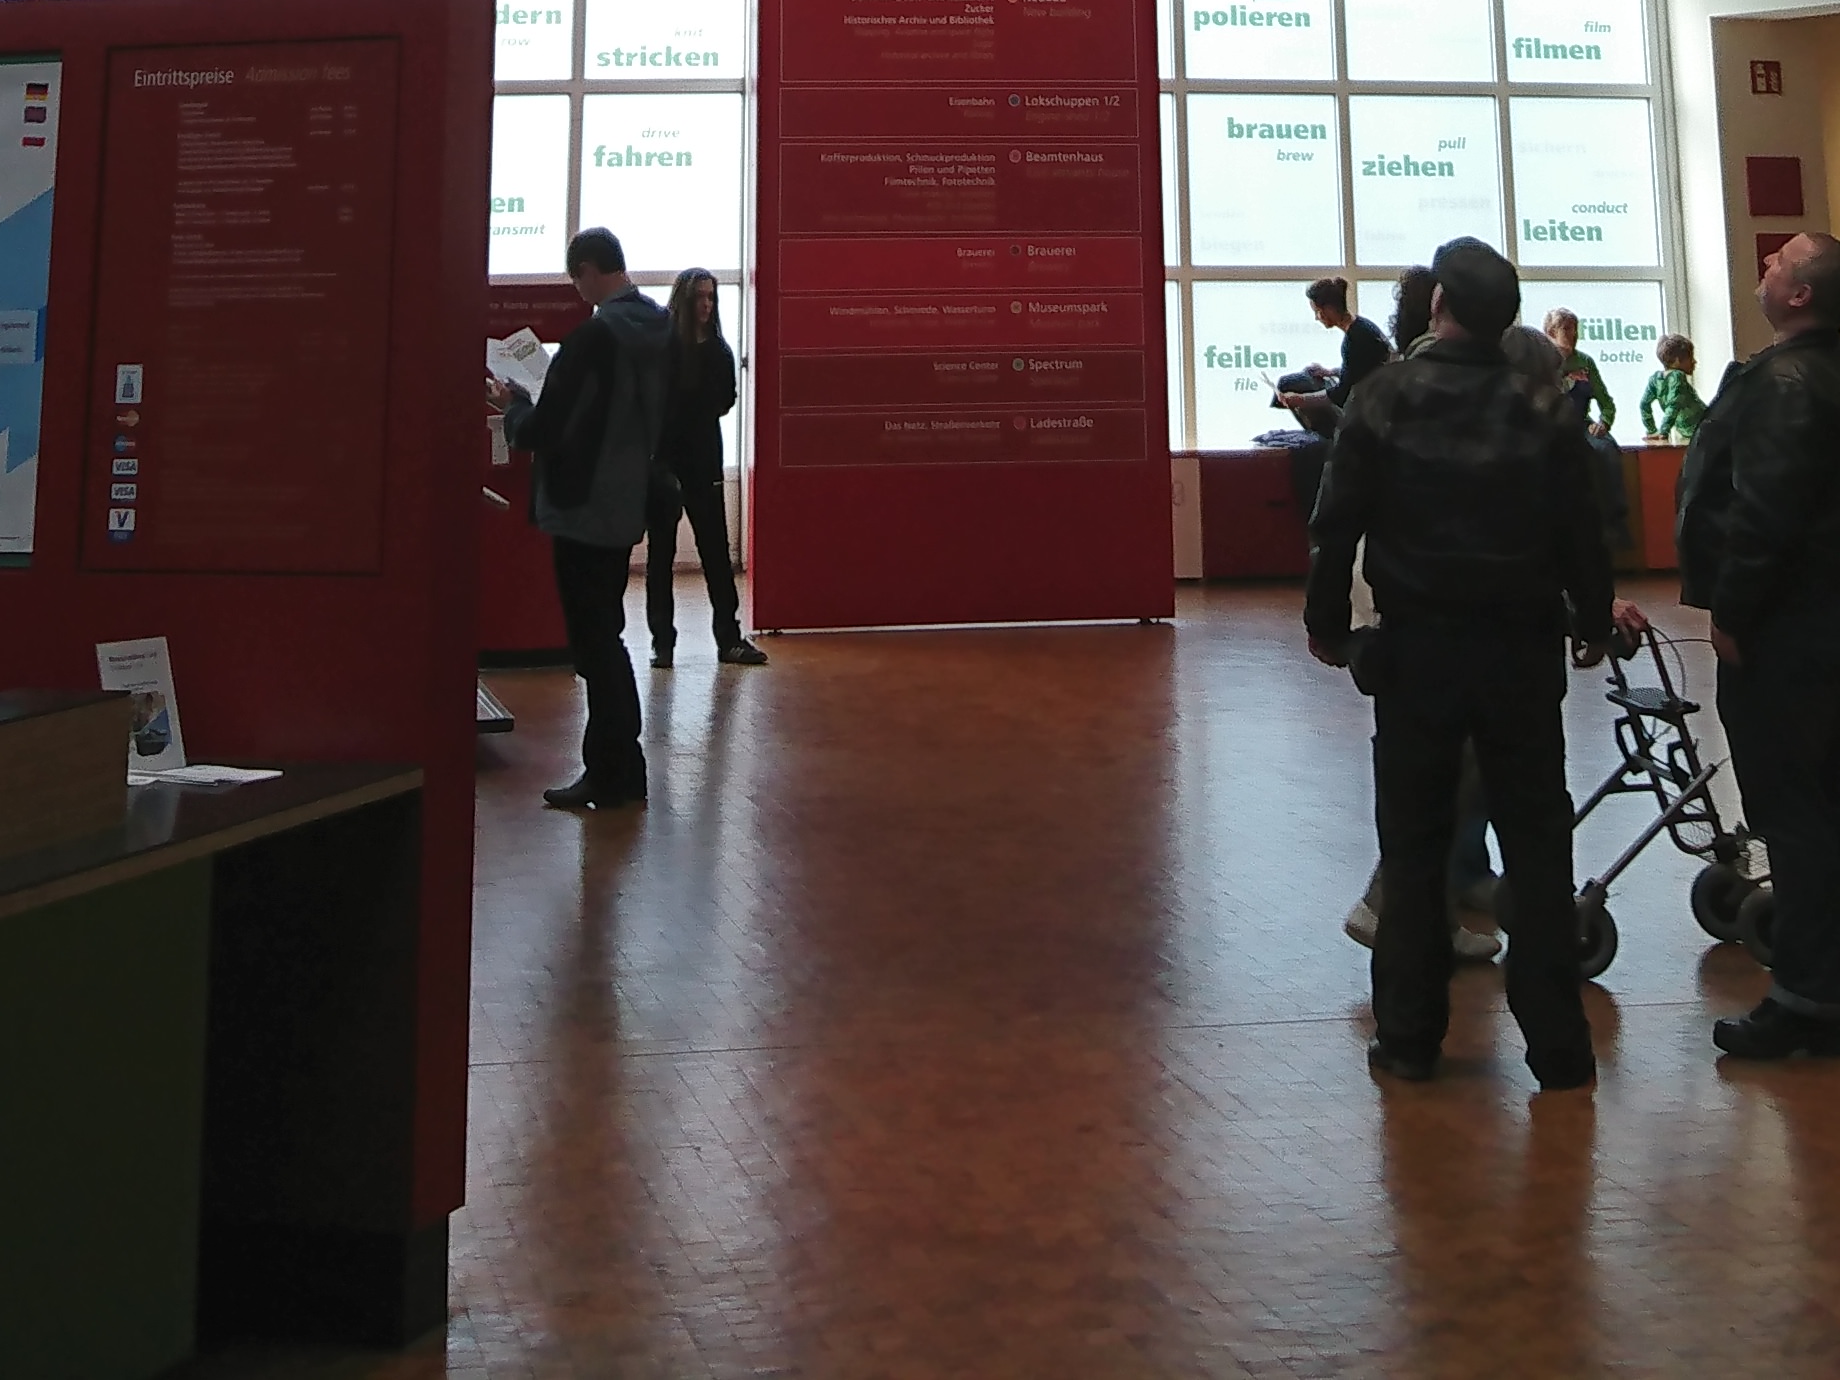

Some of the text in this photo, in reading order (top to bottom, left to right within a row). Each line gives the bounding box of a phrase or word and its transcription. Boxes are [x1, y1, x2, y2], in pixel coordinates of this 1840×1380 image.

[496, 3, 562, 25] dern
[1193, 5, 1311, 31] polieren
[1583, 20, 1612, 34] film
[1512, 37, 1602, 61] filmen
[596, 46, 720, 68] stricken
[134, 67, 235, 89] Eintrittspreise
[1025, 94, 1120, 109] Lokschuppen 1/2
[641, 126, 681, 140] drive
[1227, 117, 1327, 140] brauen
[1437, 137, 1466, 152] pull
[593, 145, 693, 168] fahren
[1026, 151, 1104, 163] Beamtenhaus
[1276, 148, 1314, 163] brew
[1361, 154, 1455, 178] ziehen
[1571, 200, 1629, 216] conduct
[492, 223, 546, 236] ansmit
[1522, 218, 1603, 243] leiten
[1027, 244, 1077, 257] Brauerei
[1028, 300, 1109, 315] Museumspark
[1578, 318, 1657, 341] füllen
[1204, 344, 1288, 369] feilen
[1599, 349, 1644, 363] bottle
[1028, 357, 1084, 372] Spectrum
[1234, 377, 1259, 393] file
[1030, 416, 1094, 429] Ladestraße
[113, 486, 135, 497] VISA
